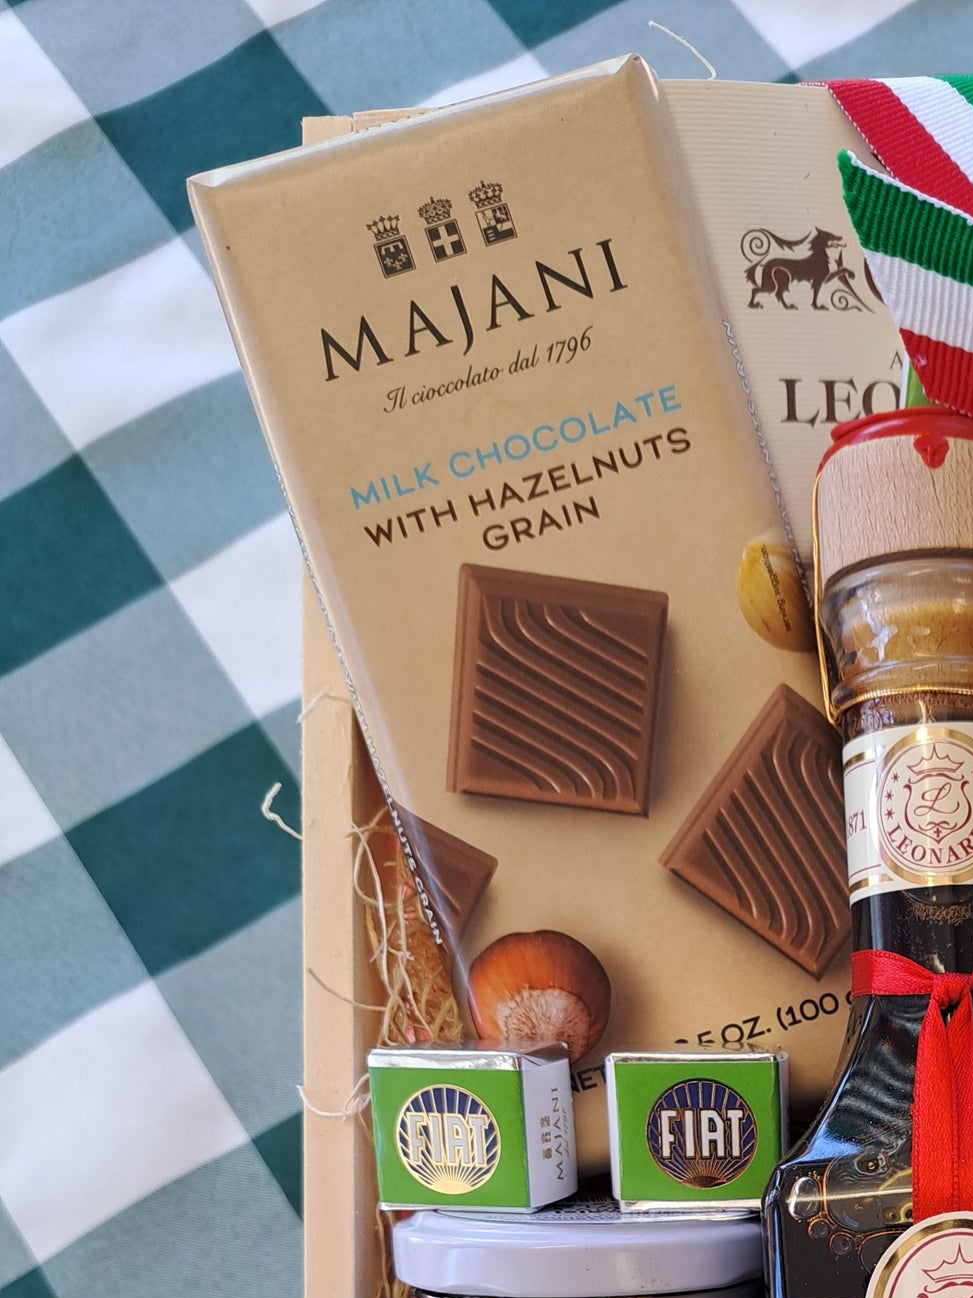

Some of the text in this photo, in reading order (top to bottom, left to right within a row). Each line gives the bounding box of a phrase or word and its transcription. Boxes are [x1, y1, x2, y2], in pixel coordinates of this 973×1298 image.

[320, 239, 628, 382] MAJANI
[383, 325, 593, 414] Il cioccolato dal 1796
[350, 384, 683, 512] MILK CHOCOLATE
[363, 427, 693, 549] WITH HAZELNUTS
[481, 496, 601, 552] GRAIN
[846, 809, 867, 839] 871
[414, 876, 444, 946] GRAIN
[405, 1111, 491, 1168] FIAT
[550, 1087, 565, 1181] MAJANI
[658, 1107, 747, 1161] FIAT
